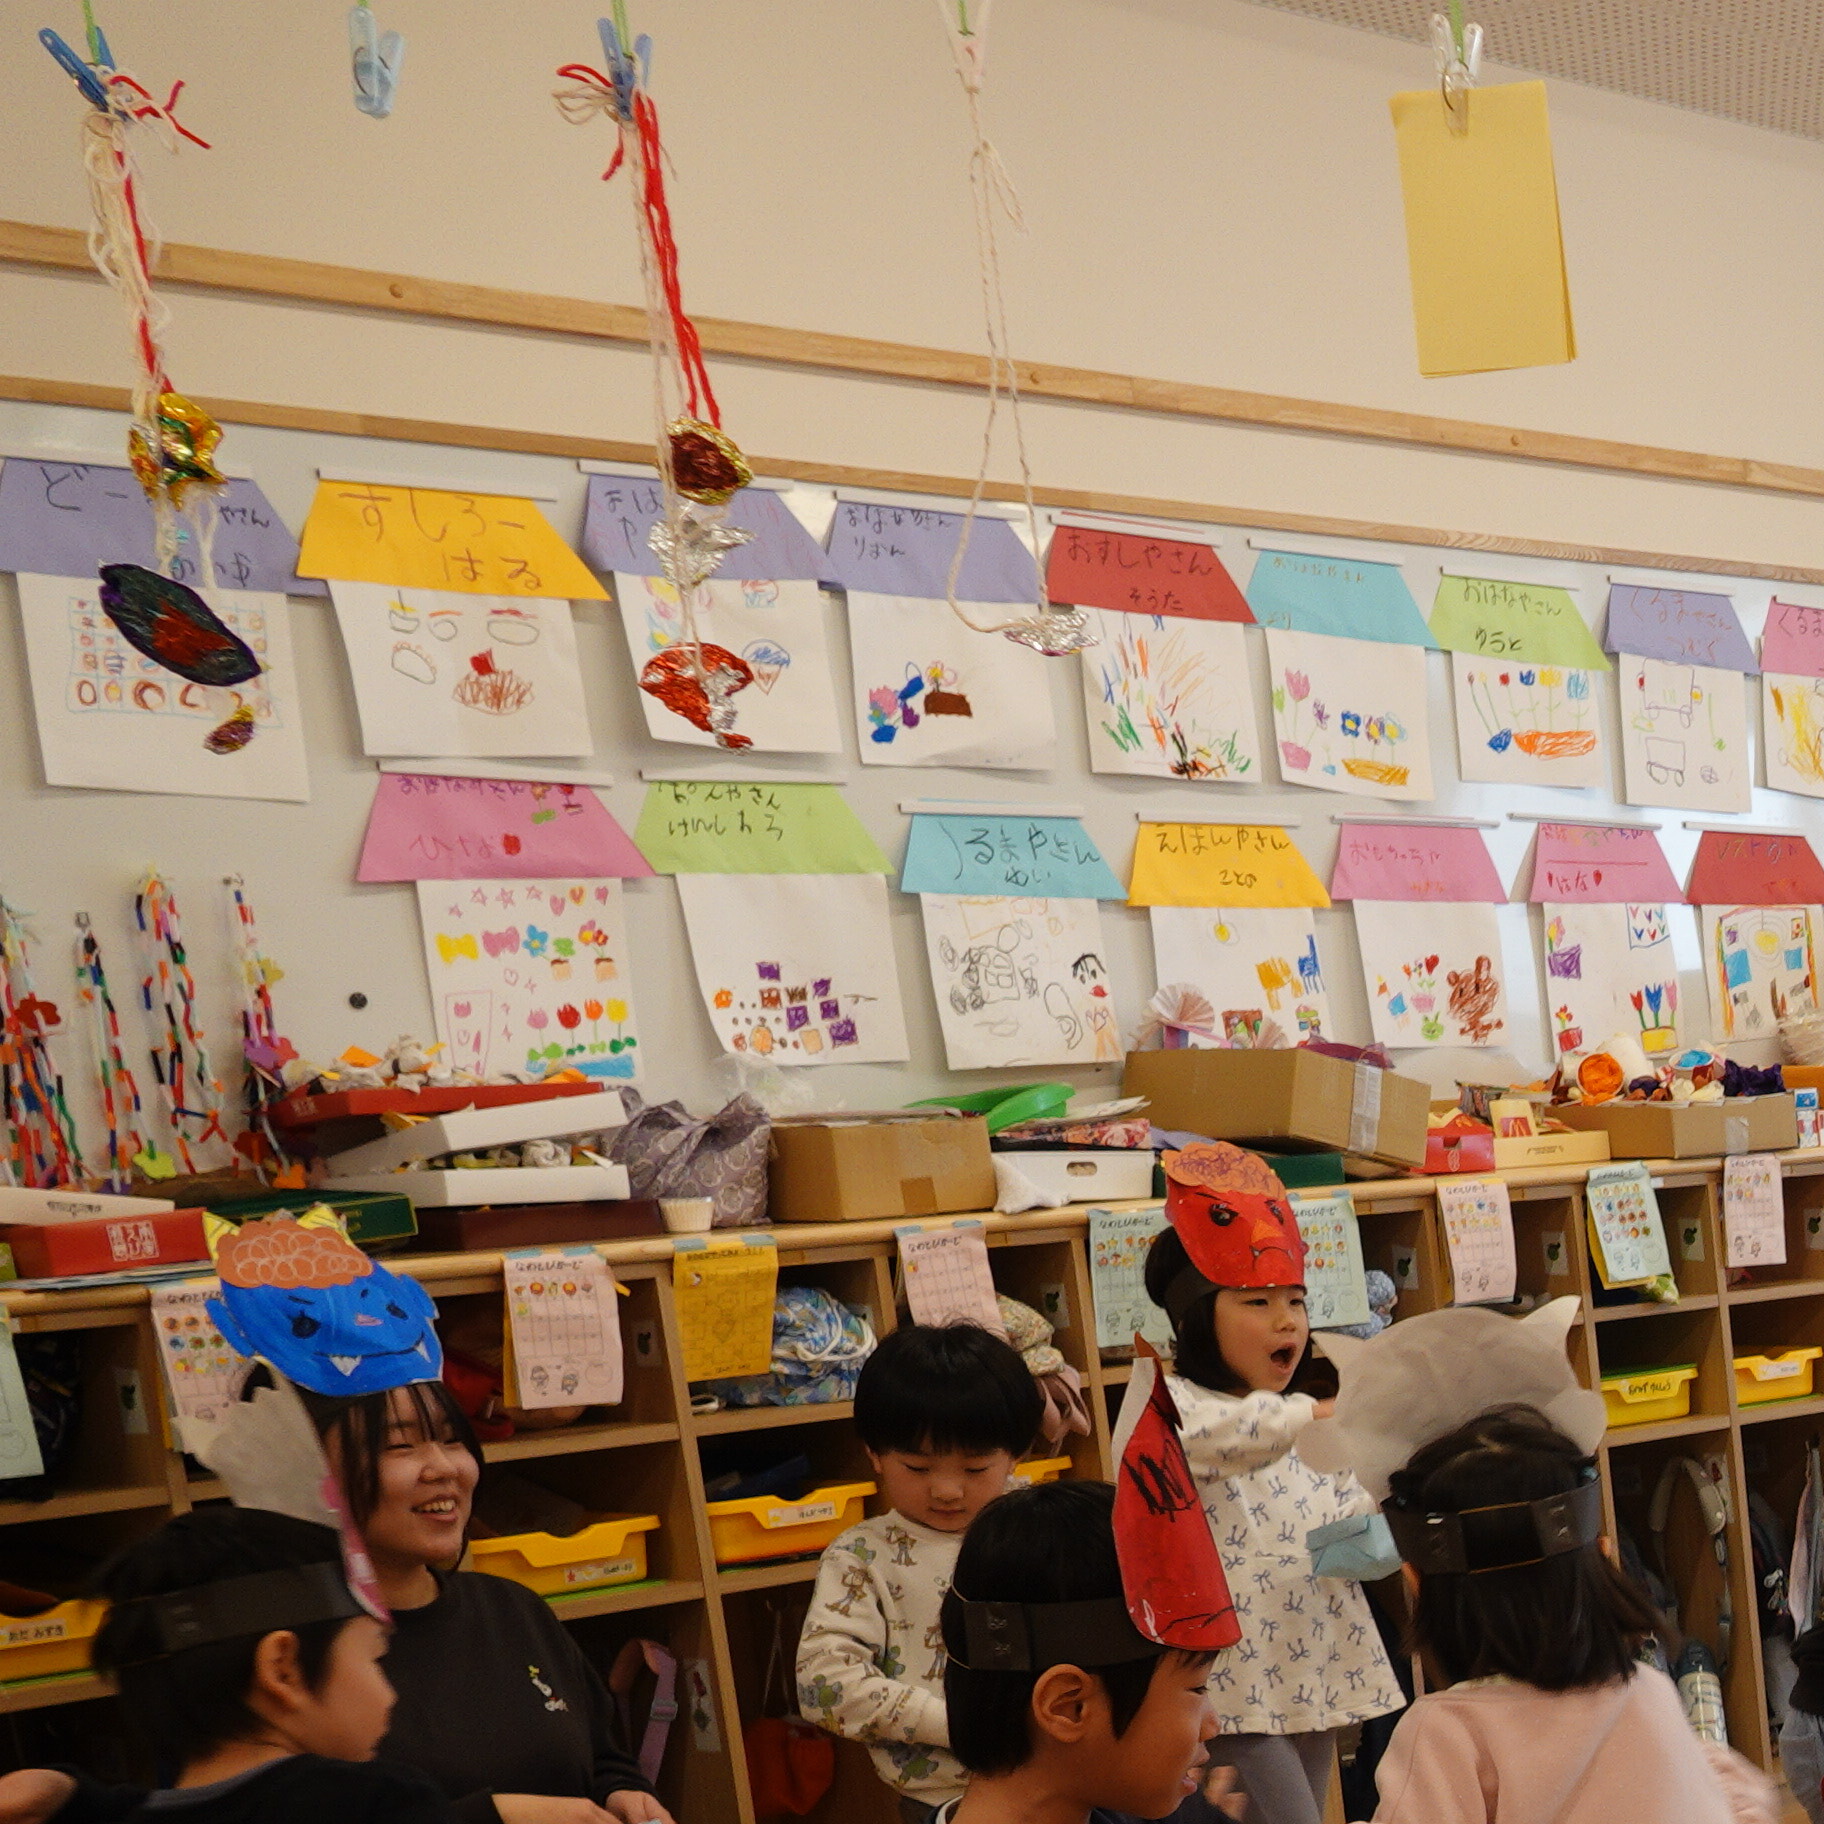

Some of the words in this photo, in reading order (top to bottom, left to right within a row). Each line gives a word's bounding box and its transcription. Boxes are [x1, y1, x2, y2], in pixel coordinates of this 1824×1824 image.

[1067, 533, 1214, 576] おすしやさん
[1464, 578, 1562, 616] おはなやさん
[1475, 626, 1523, 653] ゆうと
